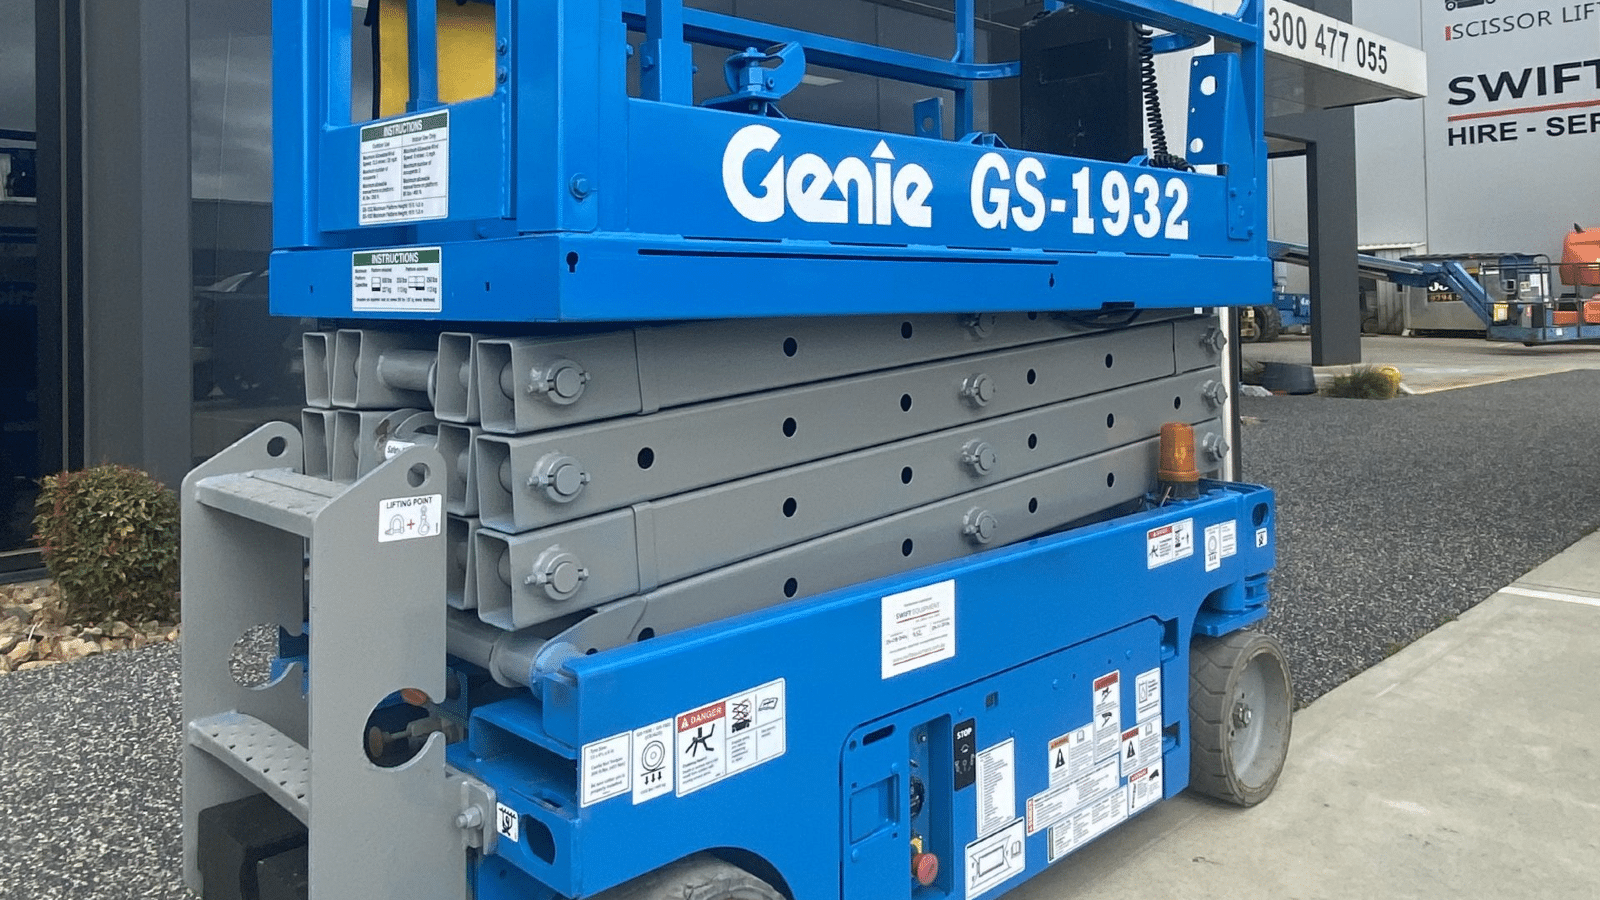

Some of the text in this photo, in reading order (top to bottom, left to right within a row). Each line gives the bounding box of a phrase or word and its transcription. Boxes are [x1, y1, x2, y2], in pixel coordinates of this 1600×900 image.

[1452, 1, 1600, 40] SCISSOR LIF
[1268, 7, 1388, 75] 300 477 055
[1447, 59, 1600, 106] SWIFT
[383, 119, 423, 137] INSTRUCTIONS
[1448, 121, 1518, 147] HIRE
[721, 123, 1190, 241] Genie GS-1932
[371, 251, 419, 264] INSTRUCTIONS
[386, 496, 433, 509] LIFTING POINT
[896, 610, 912, 620] SWIFT
[690, 705, 722, 725] DANGER
[956, 727, 973, 740] STOP
